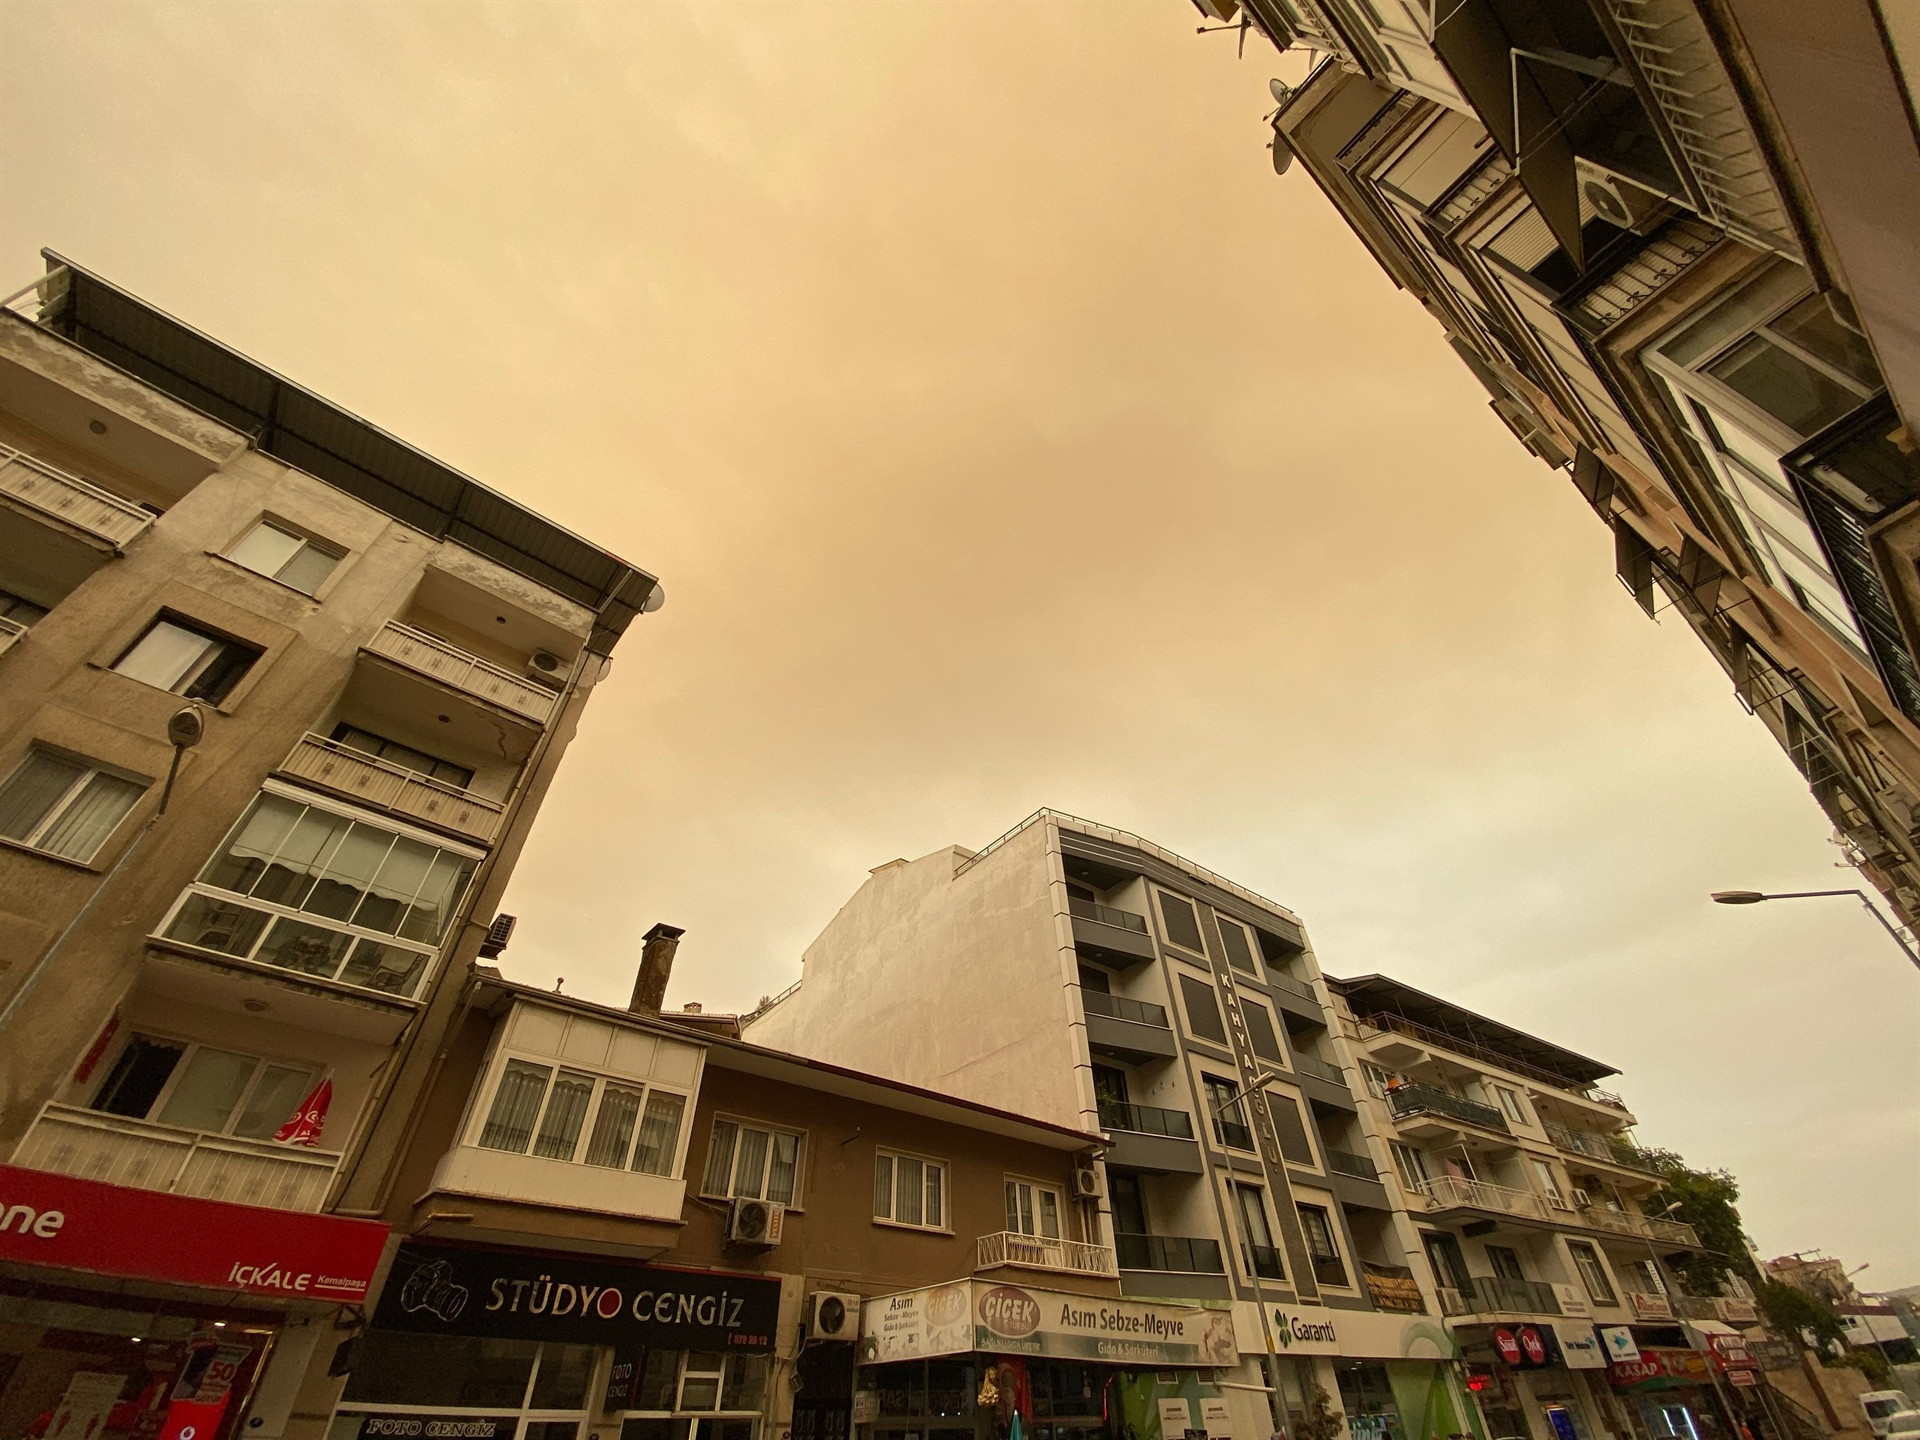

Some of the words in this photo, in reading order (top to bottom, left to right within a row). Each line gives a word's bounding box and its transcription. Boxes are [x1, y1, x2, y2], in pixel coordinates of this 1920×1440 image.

[227, 1261, 312, 1292] İÇKALE
[316, 1274, 366, 1289] Kemalpaşa
[485, 1273, 623, 1320] STÜDYO
[632, 1290, 744, 1328] CENGİZ
[890, 1298, 913, 1311] Asım
[985, 1292, 1035, 1325] ÇİÇEK
[1060, 1303, 1097, 1329] Asım
[1100, 1308, 1184, 1340] Sebze-Meyve
[1291, 1315, 1336, 1343] Garanti
[1097, 1342, 1116, 1356] Gıda
[207, 1362, 236, 1381] 50
[611, 1363, 632, 1380] FOTO
[1613, 1362, 1658, 1378] KASAP
[366, 1419, 423, 1436] FOTO
[425, 1419, 496, 1438] CENGİZ
